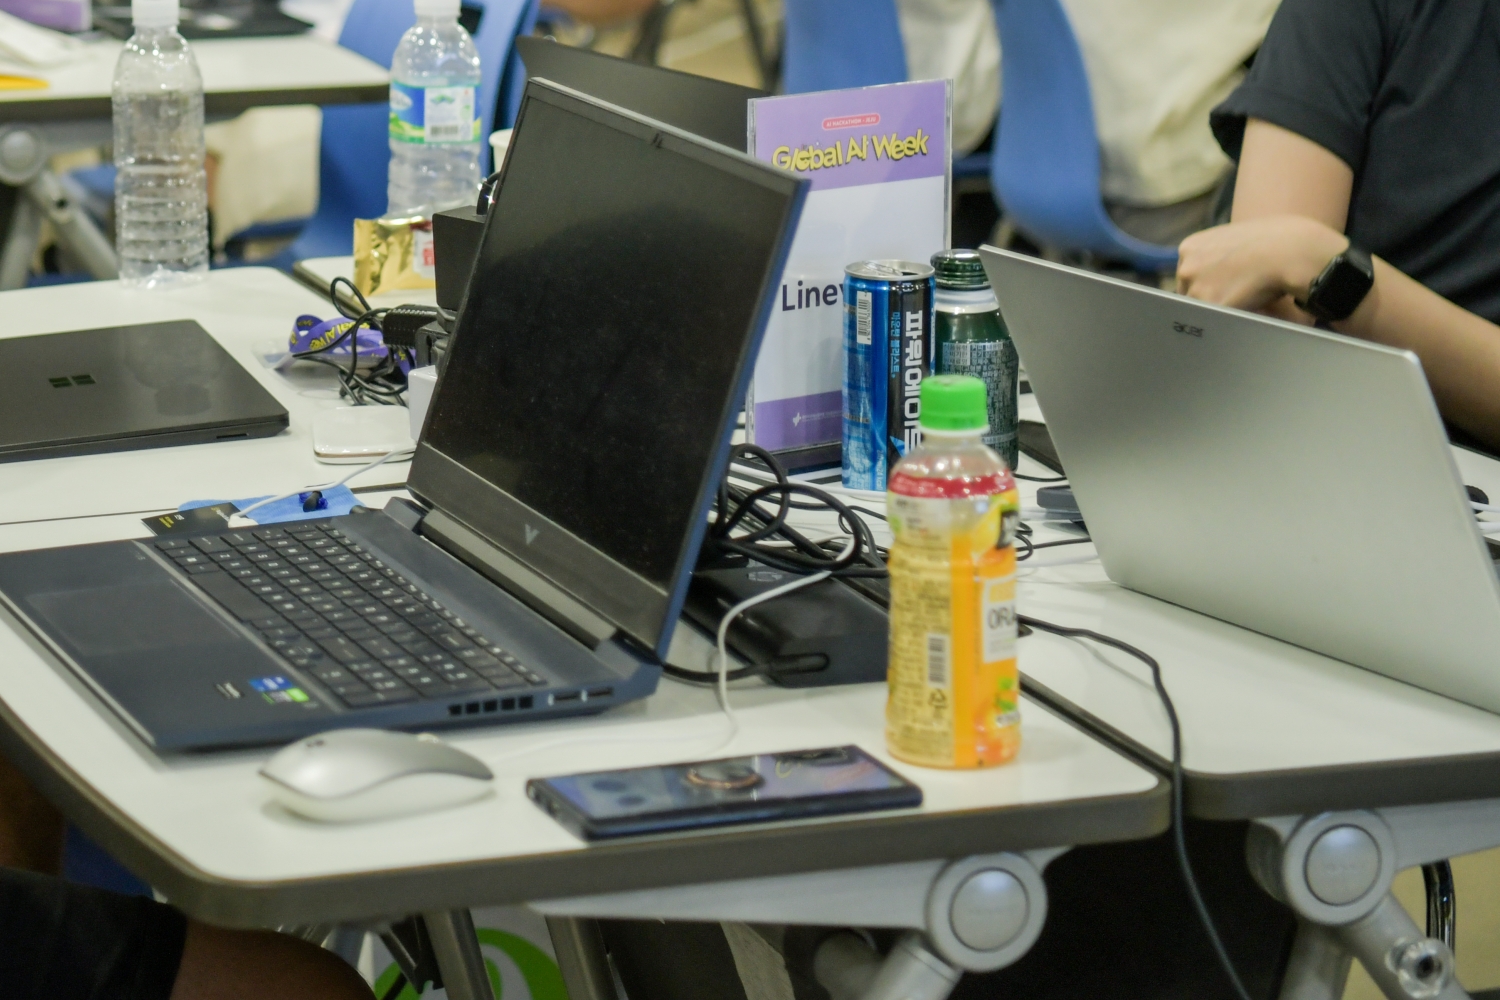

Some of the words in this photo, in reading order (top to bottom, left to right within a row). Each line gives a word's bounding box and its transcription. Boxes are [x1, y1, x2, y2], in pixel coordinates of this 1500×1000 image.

[772, 141, 843, 172] Global
[845, 134, 868, 163] AI
[871, 128, 930, 162] Week
